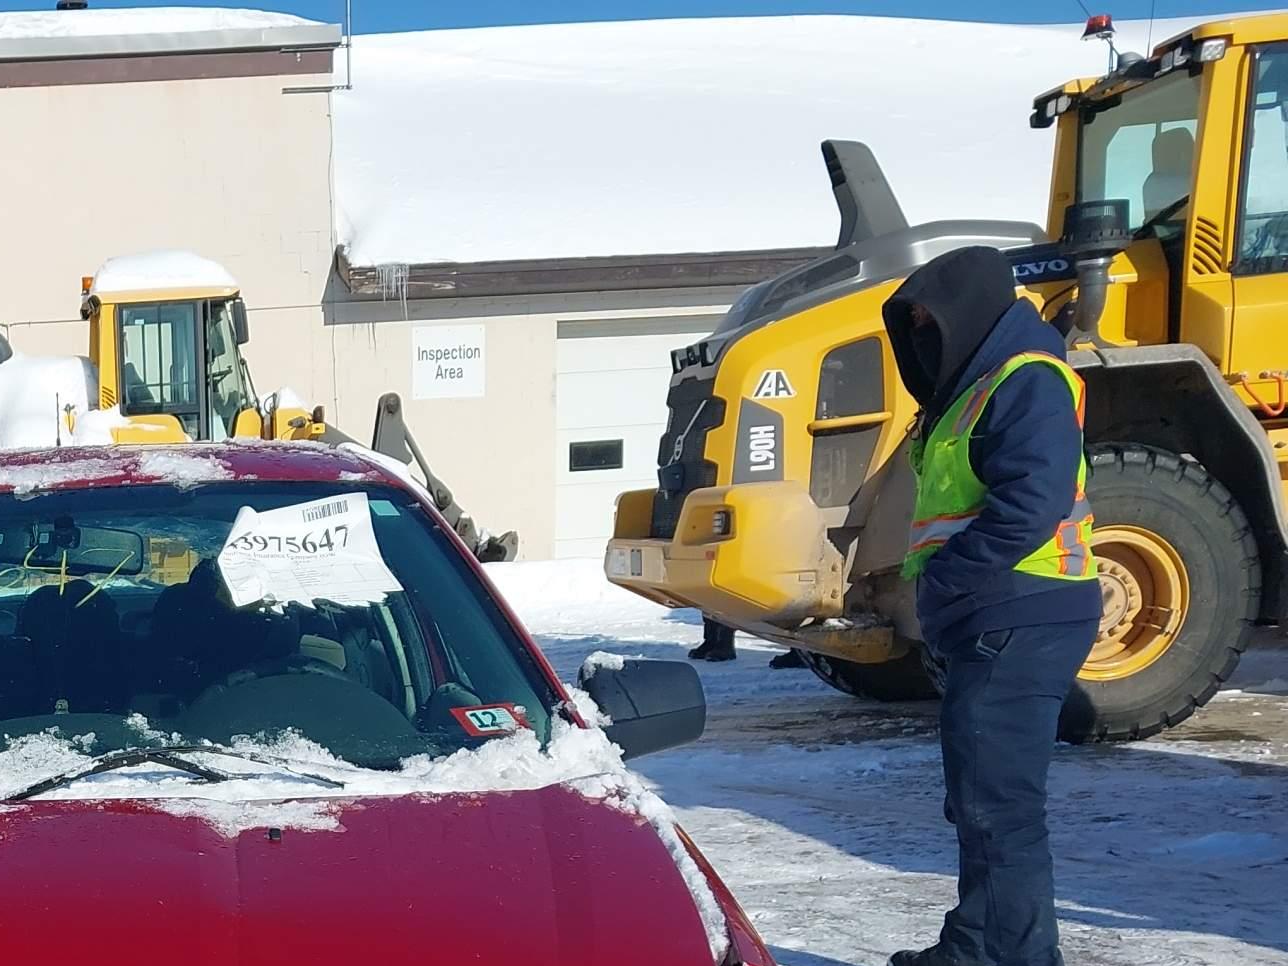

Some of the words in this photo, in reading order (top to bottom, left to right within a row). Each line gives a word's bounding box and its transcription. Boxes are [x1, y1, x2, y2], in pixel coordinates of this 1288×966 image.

[1011, 259, 1069, 277] LVO
[417, 344, 481, 363] Inspection
[435, 364, 464, 380] Area
[749, 424, 775, 472] L90H
[469, 711, 500, 728] 12
